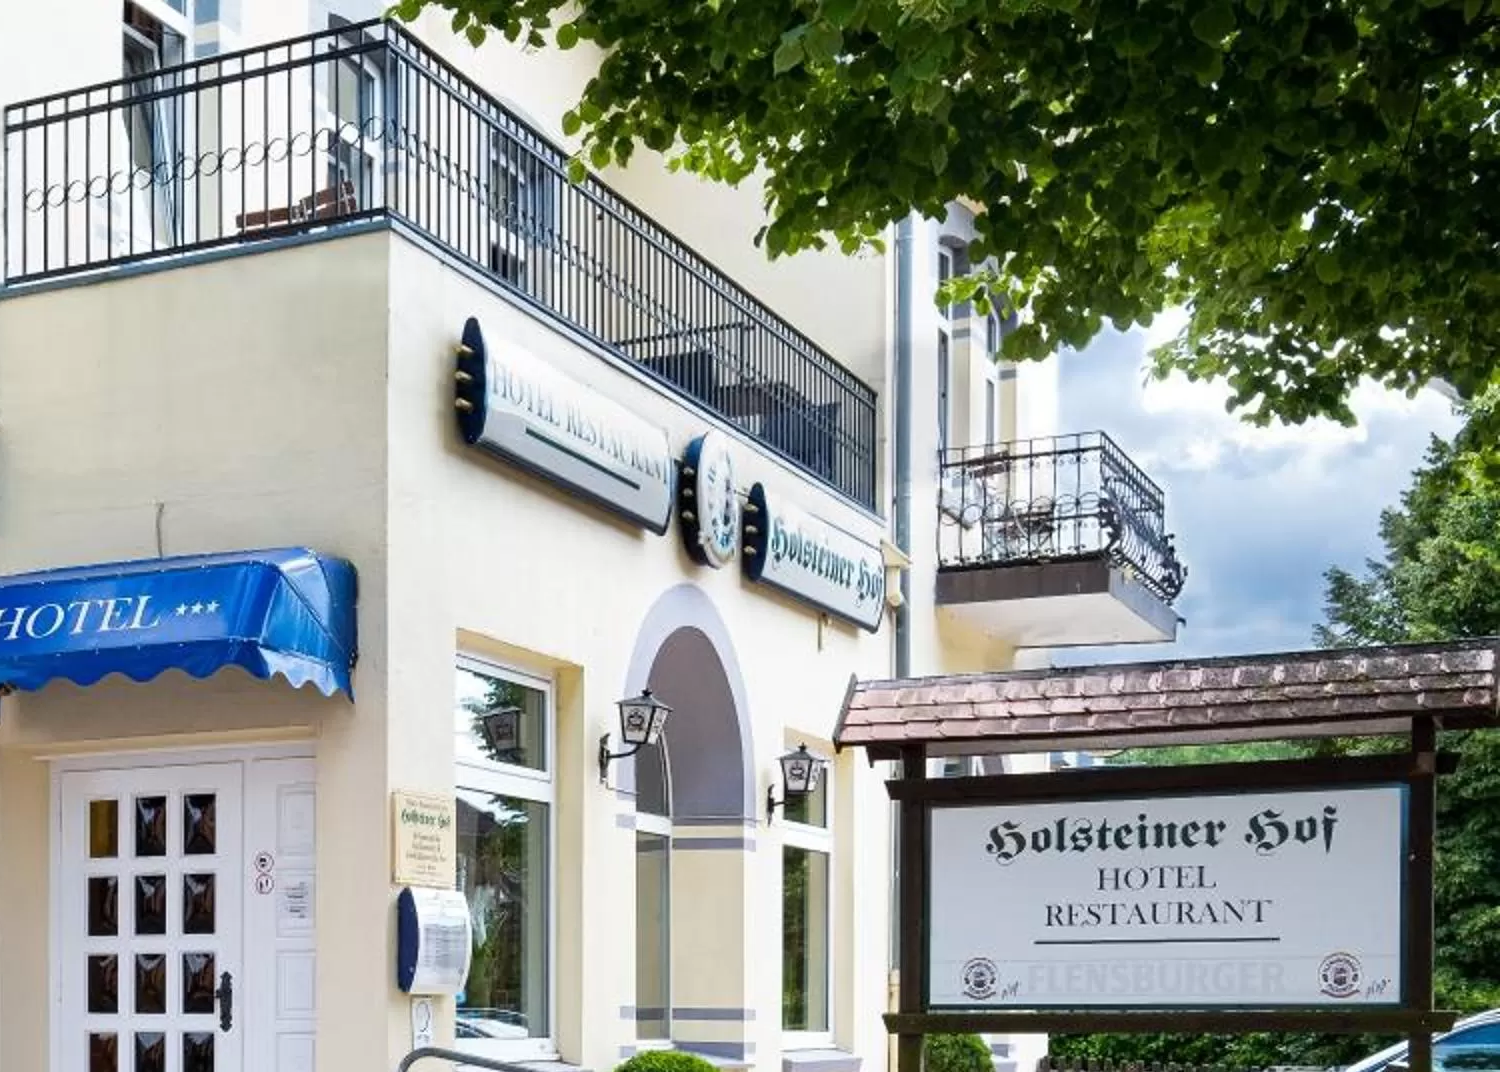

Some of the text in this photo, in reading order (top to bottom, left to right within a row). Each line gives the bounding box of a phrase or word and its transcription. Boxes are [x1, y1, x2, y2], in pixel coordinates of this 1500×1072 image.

[492, 359, 561, 427] HOTEL
[769, 514, 855, 591] Holsteiner
[985, 805, 1339, 866] Holsteiner Hof
[1097, 865, 1217, 892] HOTEL
[1045, 899, 1274, 928] RESTAURANT
[1027, 960, 1287, 995] FLENSBURGER
